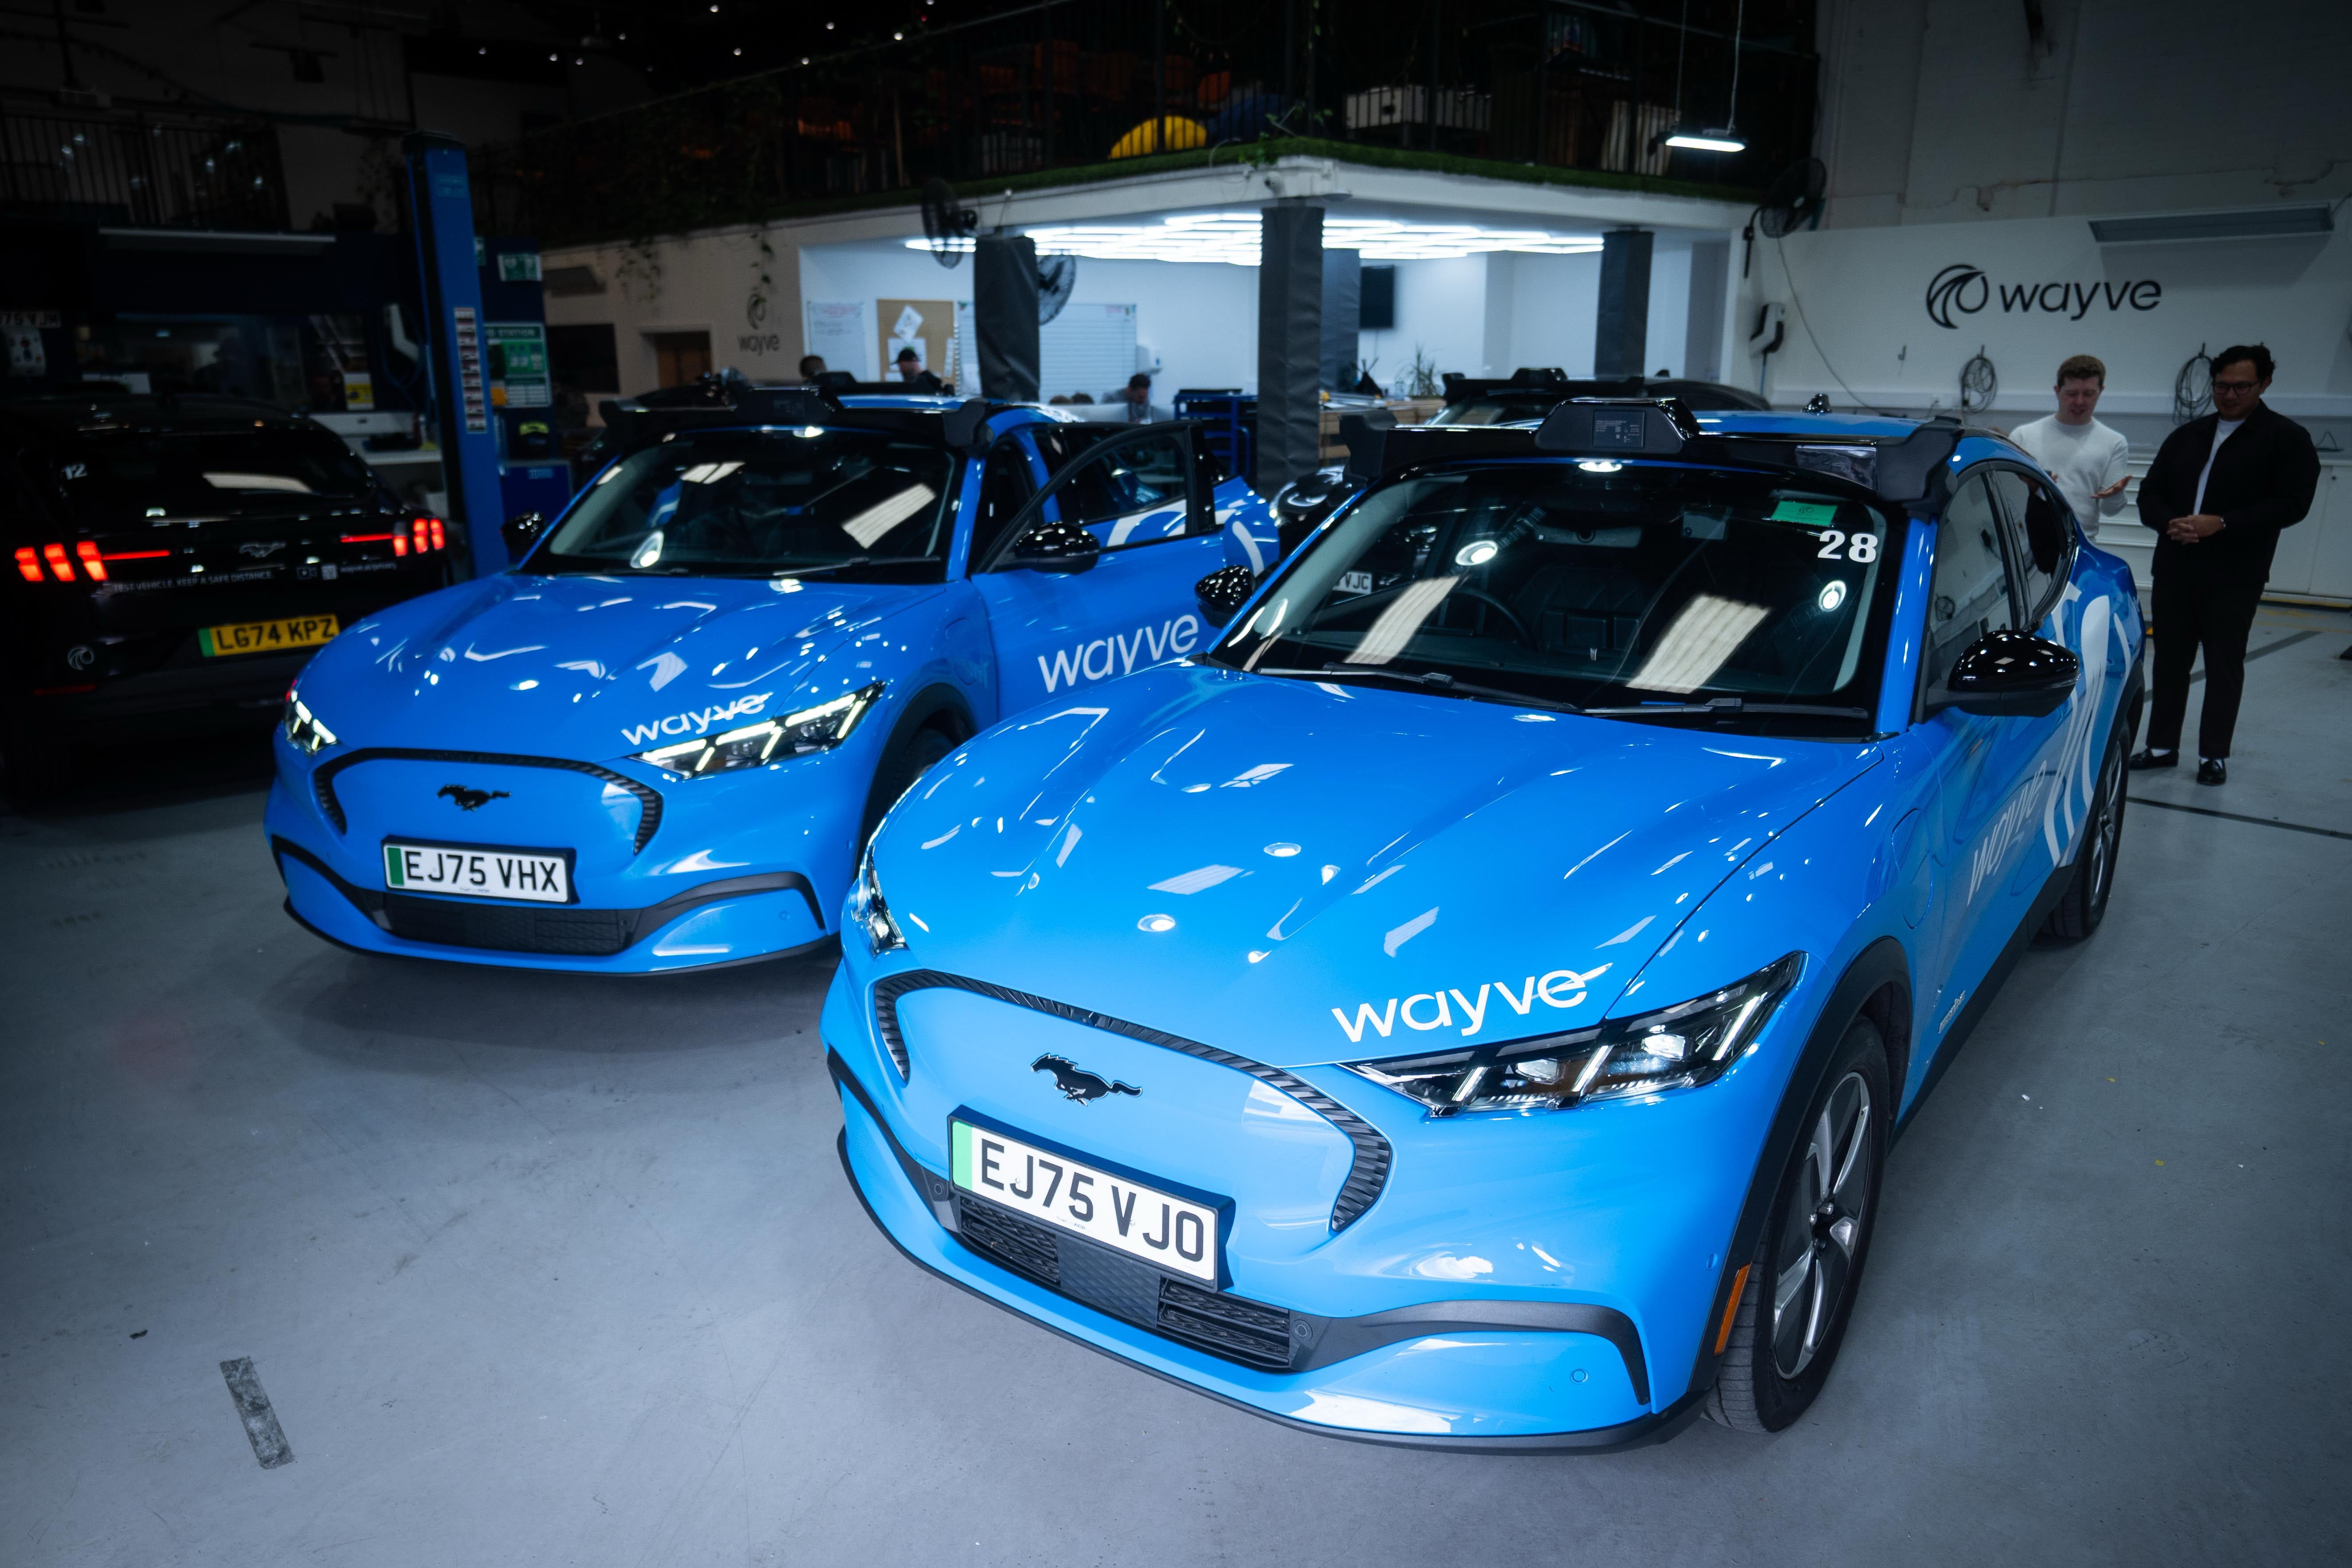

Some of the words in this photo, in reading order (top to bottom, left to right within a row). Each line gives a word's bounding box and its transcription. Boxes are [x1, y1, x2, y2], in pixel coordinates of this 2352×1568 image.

[1999, 279, 2162, 321] wayve
[738, 335, 780, 356] wayve
[1818, 530, 1878, 563] 28
[1345, 573, 1369, 590] VJC
[216, 624, 280, 650] LG74
[288, 619, 333, 642] KPZ
[1038, 614, 1199, 694] wayve
[621, 694, 765, 746] wayve
[1967, 759, 2047, 907] wayve
[404, 851, 486, 886] EJ75
[496, 858, 559, 893] VHX
[1331, 969, 1587, 1043] wayve
[981, 1138, 1094, 1222] EJ75
[1111, 1185, 1203, 1262] VJO
